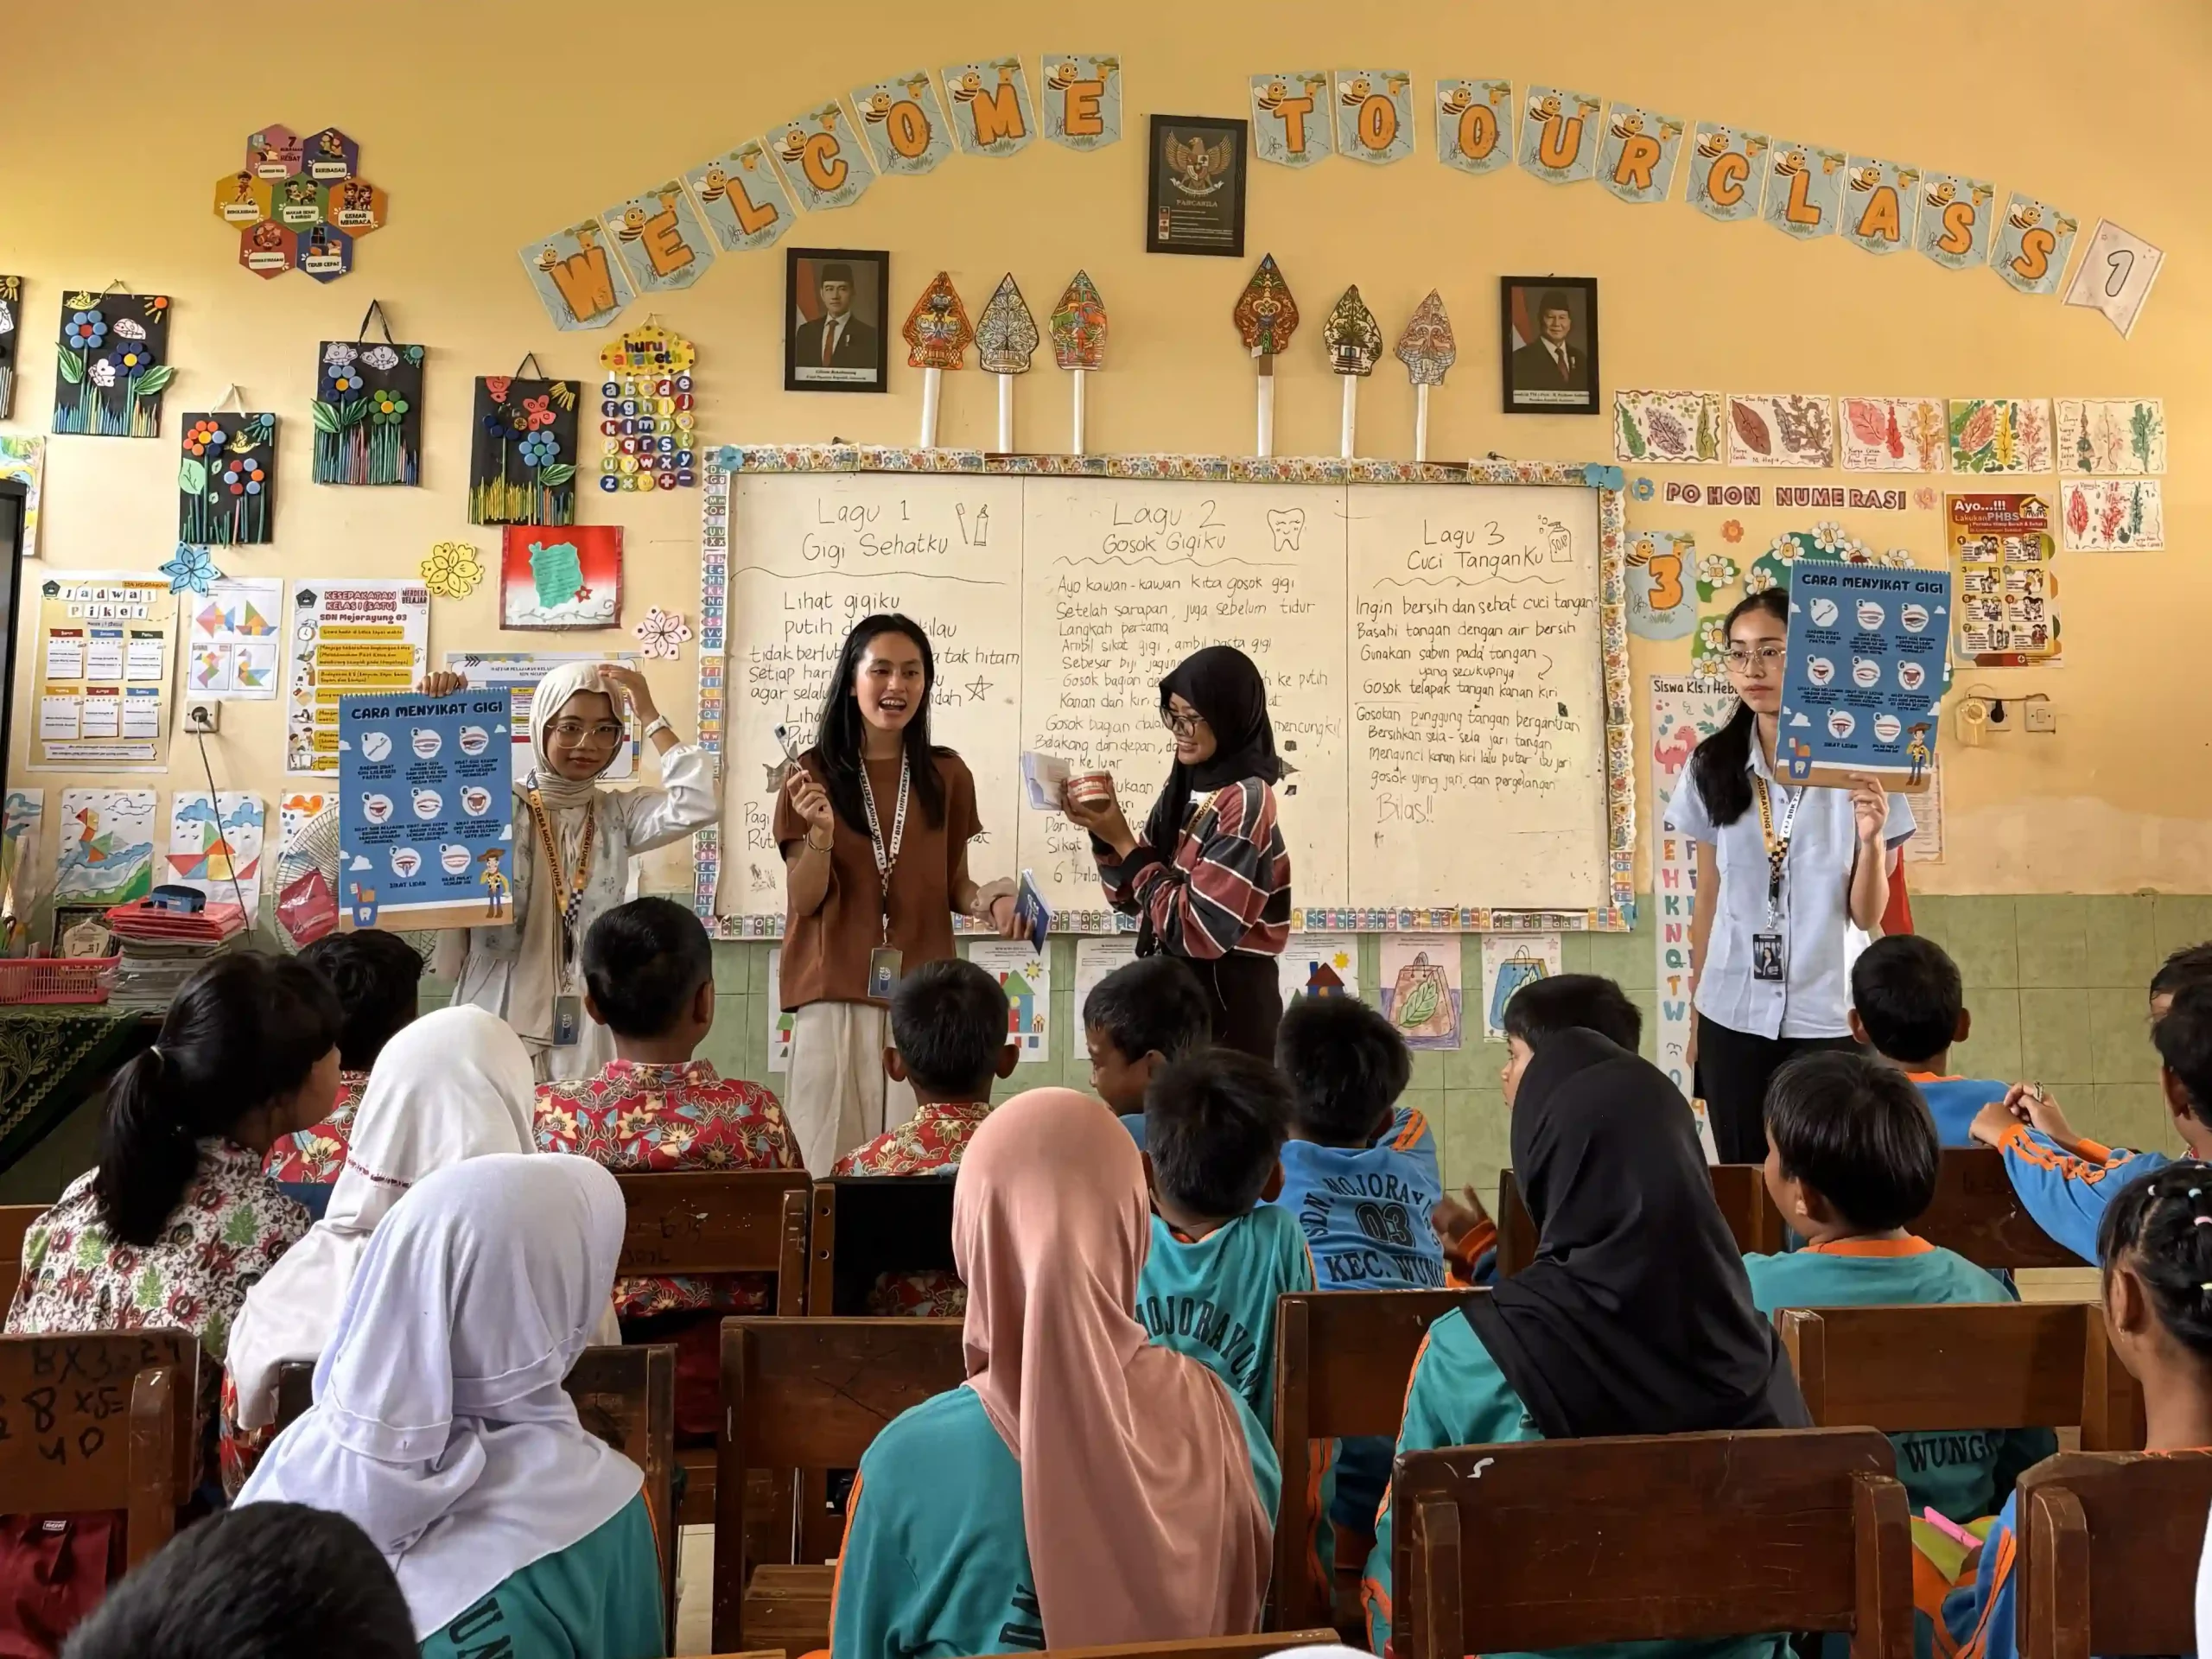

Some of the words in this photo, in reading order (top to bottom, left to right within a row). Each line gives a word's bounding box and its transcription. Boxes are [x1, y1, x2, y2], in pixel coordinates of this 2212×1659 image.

[554, 79, 1103, 323] WELCOME
[1273, 94, 1398, 154] TO
[1458, 104, 1661, 189] OUR
[1707, 151, 2056, 280] CLASS
[2106, 250, 2134, 297] 1
[1667, 482, 1760, 505] POHON
[1776, 486, 1906, 510] NUMERASI
[818, 499, 880, 532] Lagu
[900, 500, 911, 521] 1
[1113, 502, 1183, 534] Lagu
[1199, 499, 1225, 528] 2
[1987, 512, 2019, 521] PHBS
[1424, 519, 1474, 548] Lagu
[1484, 521, 1504, 545] 3
[803, 533, 845, 569] Gigi
[860, 533, 948, 556] Sehatku
[1103, 533, 1155, 554] Gosok
[1166, 532, 1225, 556] Gigiku
[1551, 536, 1567, 553] SOAP
[1408, 551, 1443, 570] Cuci
[1058, 575, 1080, 599] Ayo
[1227, 576, 1262, 597] gosok
[1272, 577, 1294, 594] gigi
[1649, 554, 1683, 610] 3
[1802, 574, 1837, 587] CARA
[1842, 577, 1910, 591] MENYIKAT
[1915, 582, 1943, 594] GIGI
[325, 591, 396, 600] KESEPAKATAN
[785, 593, 833, 610] Lihat
[845, 593, 899, 618] gigiku
[326, 601, 356, 610] KELAS
[363, 601, 397, 612] (SATU)
[1057, 602, 1107, 620] Setelah
[1184, 606, 1208, 622] juga
[1217, 602, 1267, 617] sebelum
[1280, 602, 1316, 614] tidur
[1357, 595, 1392, 621] Ingin
[1403, 595, 1447, 614] bersih
[1453, 599, 1475, 613] dan
[1478, 595, 1516, 613] sehat
[1523, 596, 1548, 610] cuci
[1555, 591, 1593, 615] tangan
[785, 619, 832, 642] putih
[1059, 622, 1112, 640] Langkah
[1122, 622, 1168, 635] pertama
[1357, 622, 1397, 639] Basahi
[1406, 624, 1450, 643] tangan
[1459, 623, 1502, 641] dengan
[1509, 624, 1529, 636] air
[1535, 622, 1575, 636] bersih
[1063, 638, 1094, 653] Ambil
[1102, 638, 1128, 651] sikat
[1175, 636, 1205, 650] ambil
[1251, 638, 1272, 653] gigi
[1361, 645, 1410, 661] Gunakan
[1419, 646, 1450, 660] sabun
[1457, 646, 1483, 663] pada
[1490, 648, 1536, 664] tangan
[749, 646, 792, 663] tidak
[945, 647, 969, 664] tak
[976, 646, 1019, 664] hitam
[1063, 657, 1112, 670] Sebesar
[1120, 658, 1137, 672] biji
[749, 667, 795, 684] Setiap
[803, 667, 832, 679] hari
[1063, 674, 1098, 688] Gosok
[1104, 674, 1141, 693] bagian
[1300, 672, 1327, 690] putih
[1419, 666, 1447, 683] yang
[1452, 666, 1514, 683] secukupnya
[751, 687, 785, 705] agar
[1363, 679, 1402, 693] Gosok
[1410, 678, 1450, 698] telapak
[1459, 683, 1494, 702] tangan
[1500, 684, 1533, 699] kanan
[1538, 686, 1557, 698] kiri
[1654, 680, 1683, 693] Siswa
[351, 708, 390, 720] CARA
[396, 702, 468, 718] MENYIKAT
[473, 702, 503, 714] GIGI
[1101, 693, 1123, 709] dan
[1130, 695, 1150, 709] kiri
[785, 708, 821, 723] Liha
[1411, 709, 1462, 728] punggung
[1468, 709, 1510, 731] tangan
[1046, 716, 1083, 731] Gosok
[1090, 719, 1130, 740] bagian
[1033, 735, 1089, 753] Belakang
[1096, 737, 1117, 751] dan
[1369, 725, 1421, 741] Bersihkan
[1490, 735, 1508, 750] jari
[1516, 735, 1552, 755] tangan
[1098, 753, 1122, 769] luar
[1429, 750, 1455, 764] kanan
[1459, 750, 1476, 763] kiri
[1481, 750, 1497, 763] lalu
[1502, 752, 1531, 765] putar
[1552, 757, 1572, 772] jari
[1371, 770, 1407, 791] gosok
[1443, 772, 1462, 791] jari
[1469, 774, 1490, 785] dan
[745, 802, 769, 830] Pagi
[1047, 837, 1082, 854] Sikat
[1356, 1202, 1415, 1248] 03
